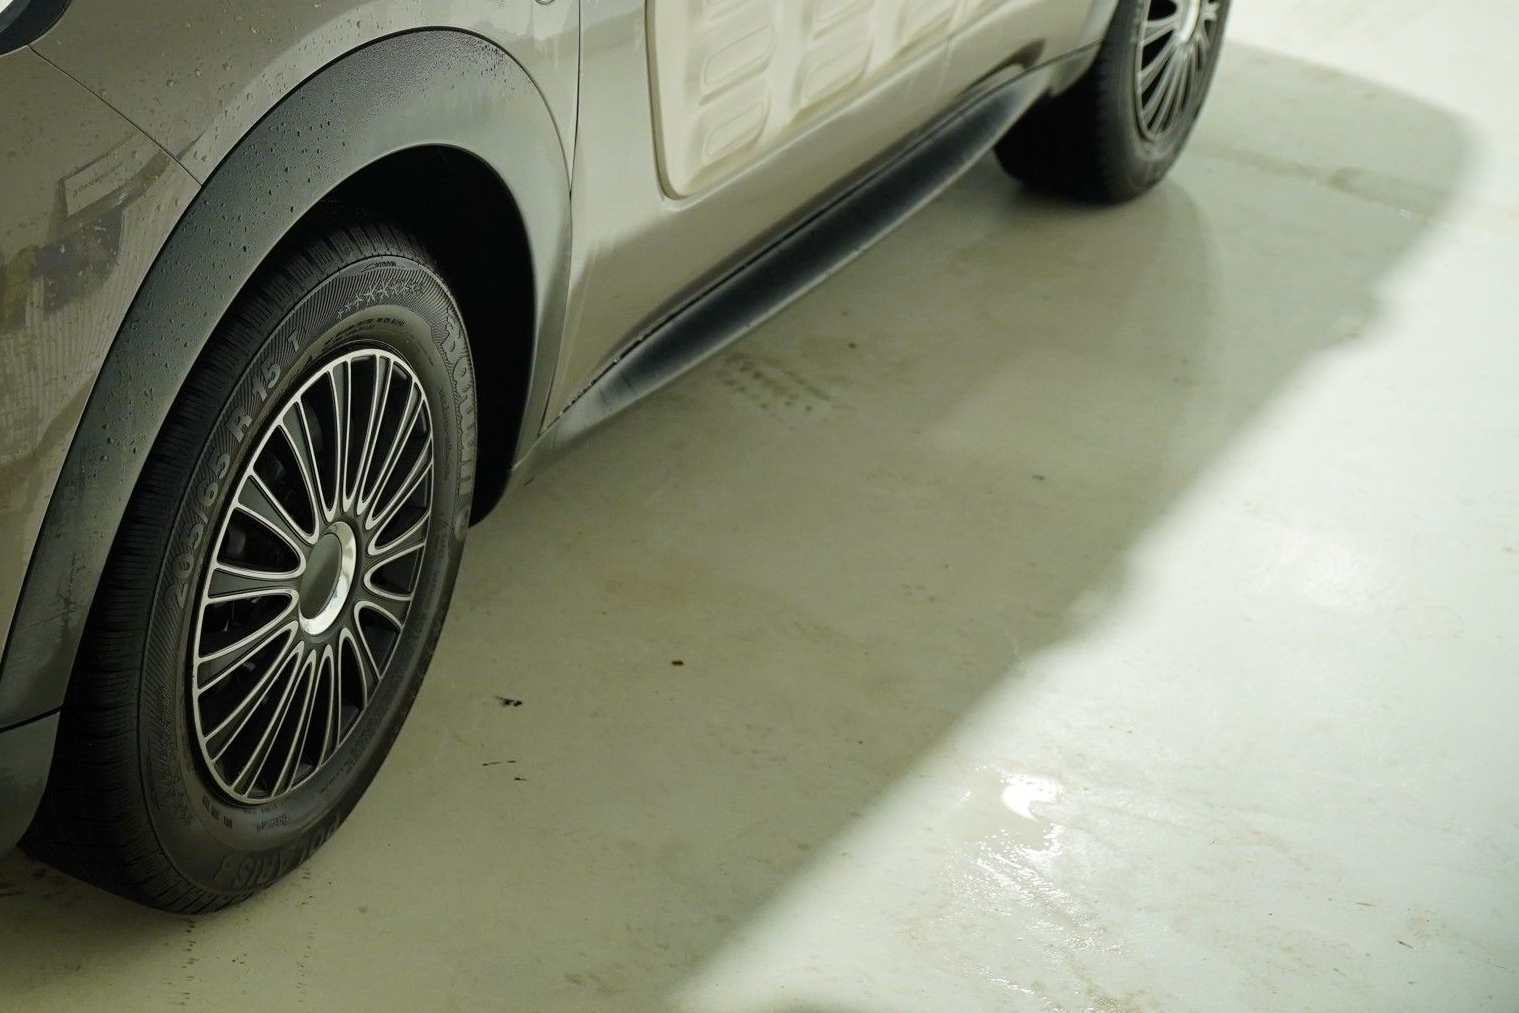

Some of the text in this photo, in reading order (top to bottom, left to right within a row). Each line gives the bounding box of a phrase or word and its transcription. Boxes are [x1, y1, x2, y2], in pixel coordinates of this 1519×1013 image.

[163, 448, 232, 610] 205/65
[226, 407, 253, 444] R
[252, 361, 282, 403] 15
